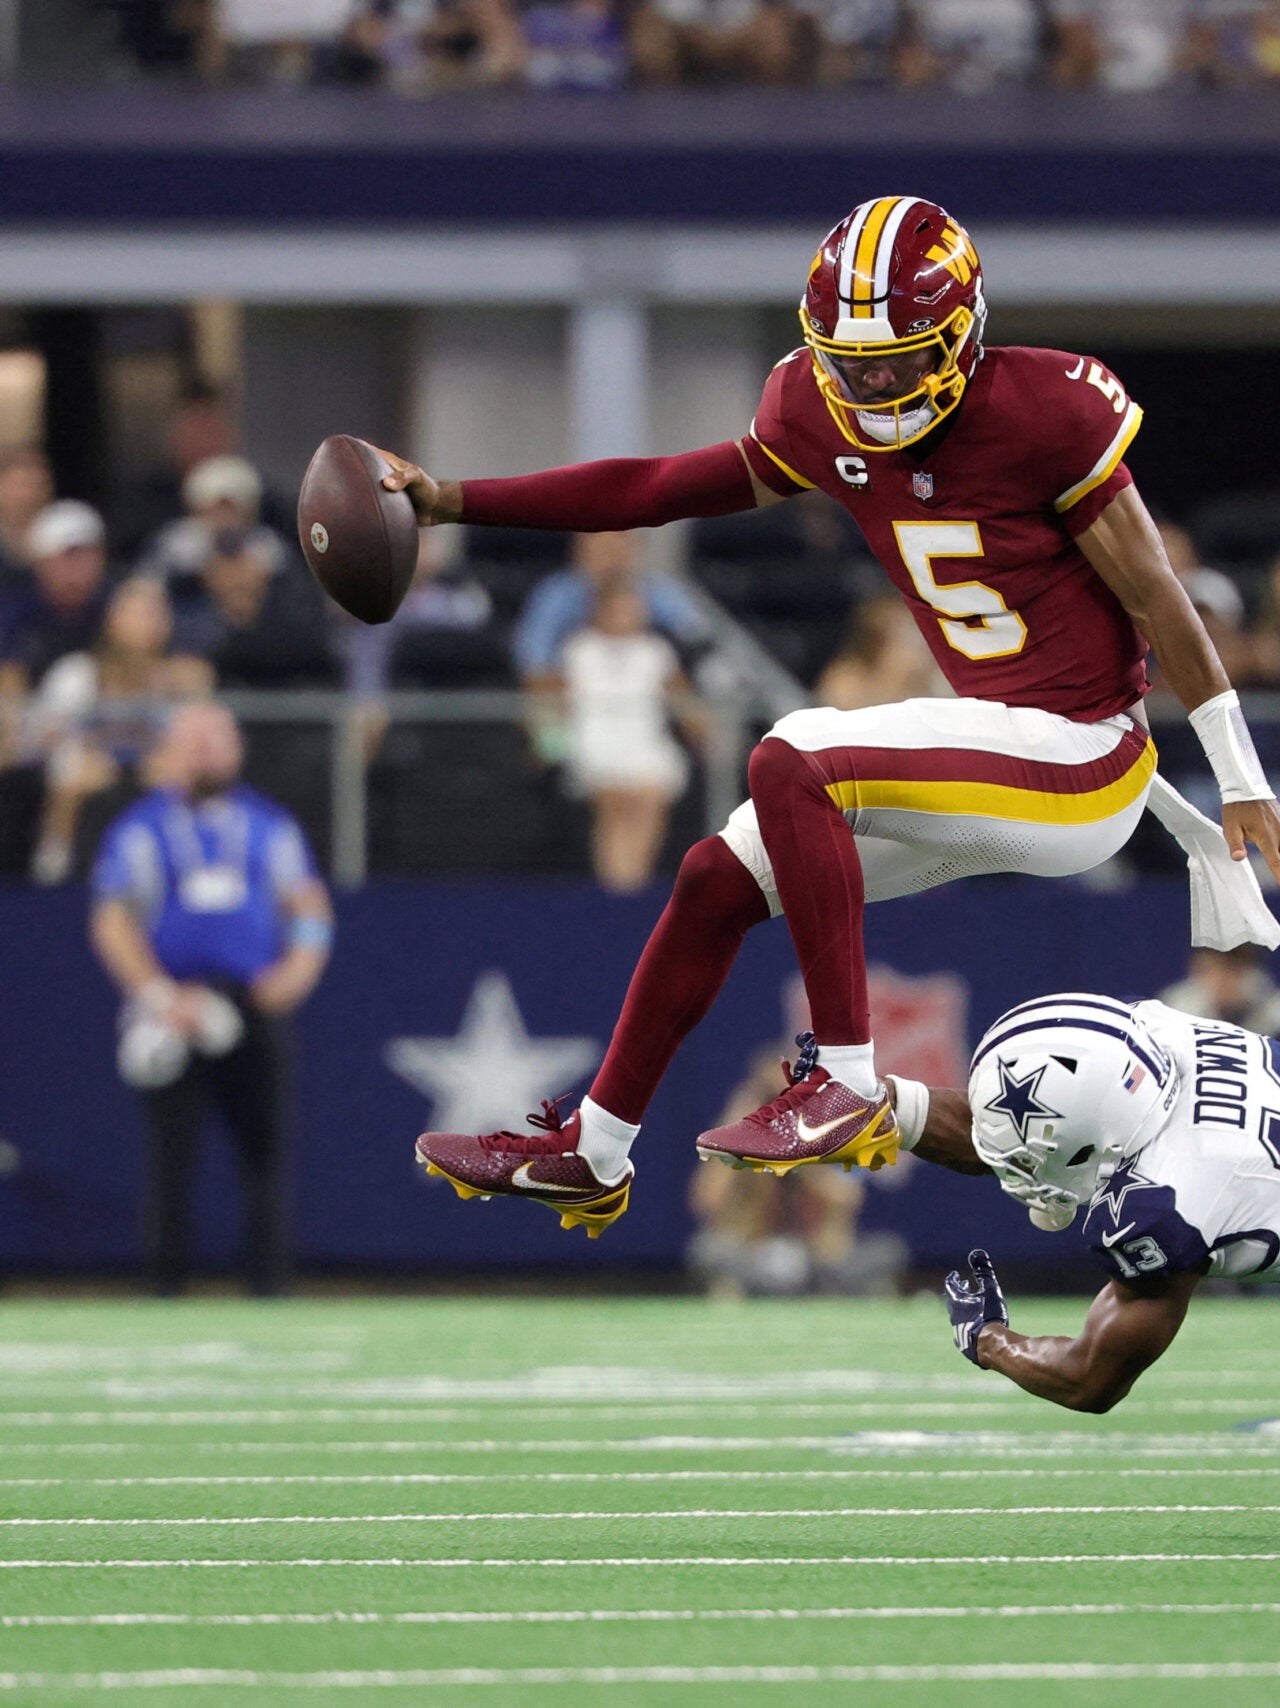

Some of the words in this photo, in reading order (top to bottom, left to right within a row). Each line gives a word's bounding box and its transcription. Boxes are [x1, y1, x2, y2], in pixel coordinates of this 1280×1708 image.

[1086, 362, 1126, 413] 5
[835, 456, 868, 485] C
[892, 520, 1028, 661] 5
[1190, 1022, 1248, 1130] DOWN
[1108, 1236, 1168, 1279] 13
